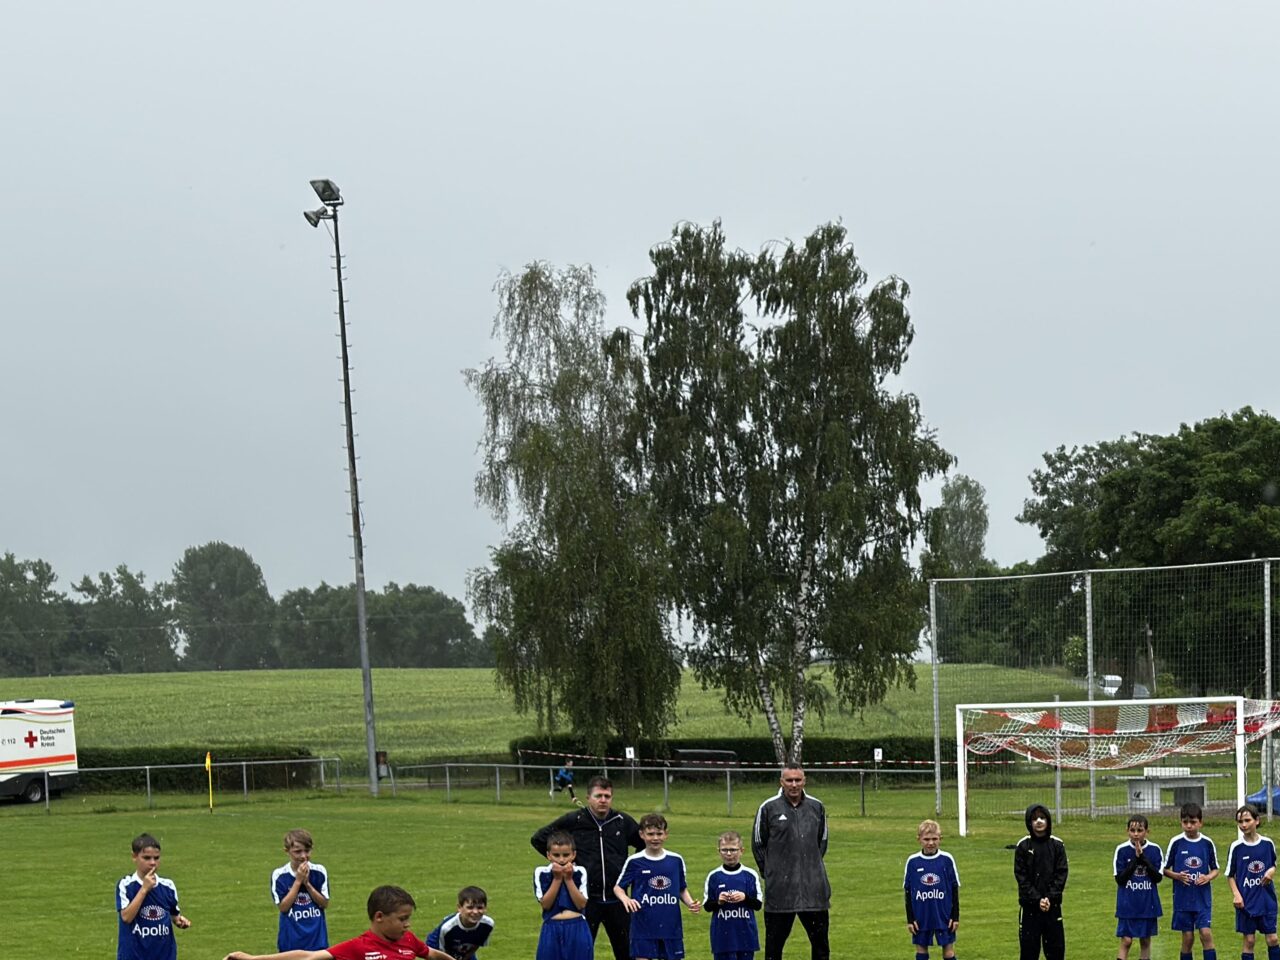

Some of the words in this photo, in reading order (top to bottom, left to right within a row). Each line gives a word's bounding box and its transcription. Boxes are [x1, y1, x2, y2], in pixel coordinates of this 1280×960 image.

[641, 893, 677, 907] Apollo
[916, 888, 945, 902] Apollo
[288, 907, 321, 922] Apollo
[717, 907, 751, 920] Apollo
[132, 923, 170, 938] Apollo
